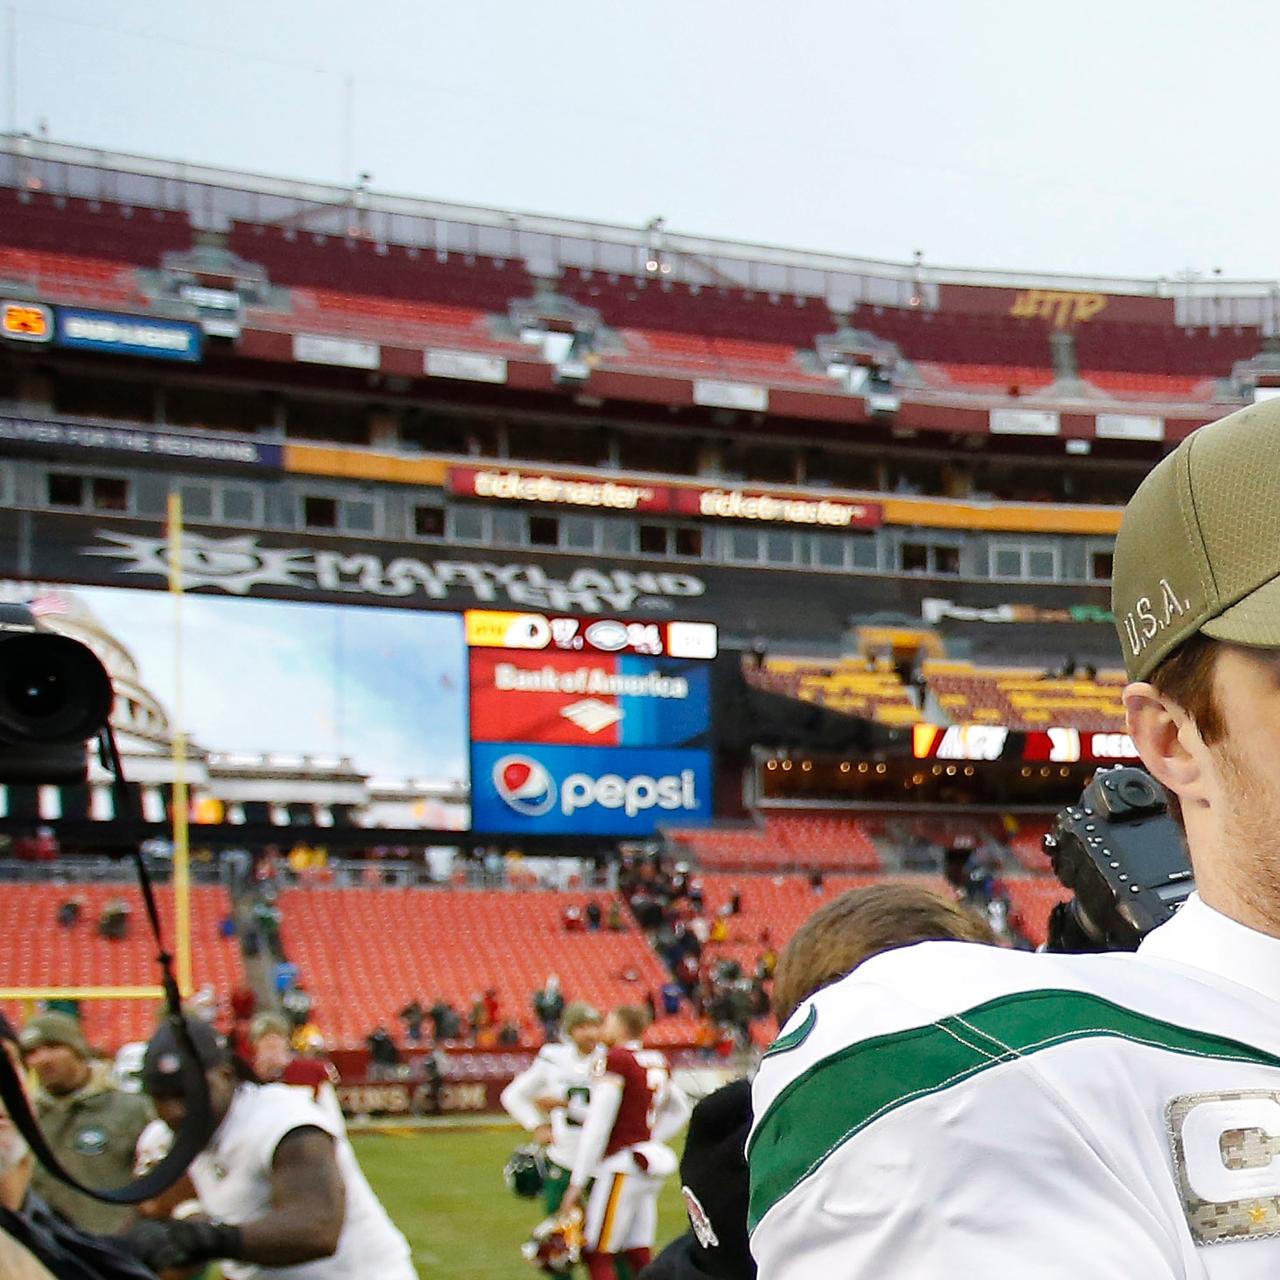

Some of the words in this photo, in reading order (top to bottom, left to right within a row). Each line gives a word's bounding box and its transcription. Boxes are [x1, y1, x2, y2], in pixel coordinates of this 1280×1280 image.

[1123, 578, 1190, 657] U.S.A.
[495, 662, 558, 694] Bank
[560, 666, 588, 695] of
[588, 668, 690, 699] America
[561, 768, 700, 817] pepsi
